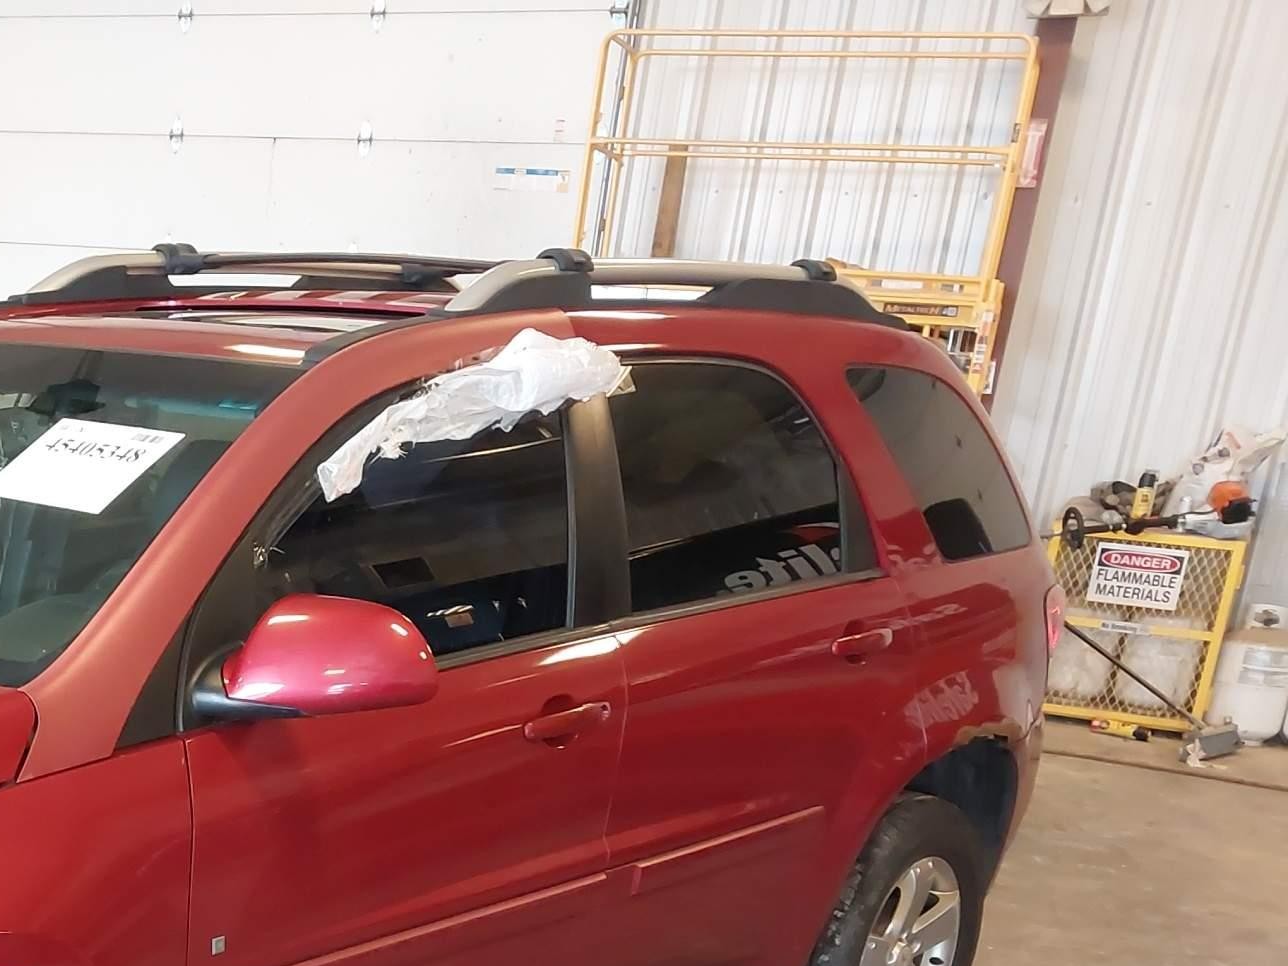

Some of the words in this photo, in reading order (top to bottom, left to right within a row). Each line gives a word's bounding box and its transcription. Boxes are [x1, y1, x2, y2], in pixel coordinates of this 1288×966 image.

[46, 438, 146, 462] 45405348
[1109, 553, 1172, 570] DANGER
[1096, 568, 1177, 588] FLAMMABLE
[1095, 584, 1171, 603] MATERIALS
